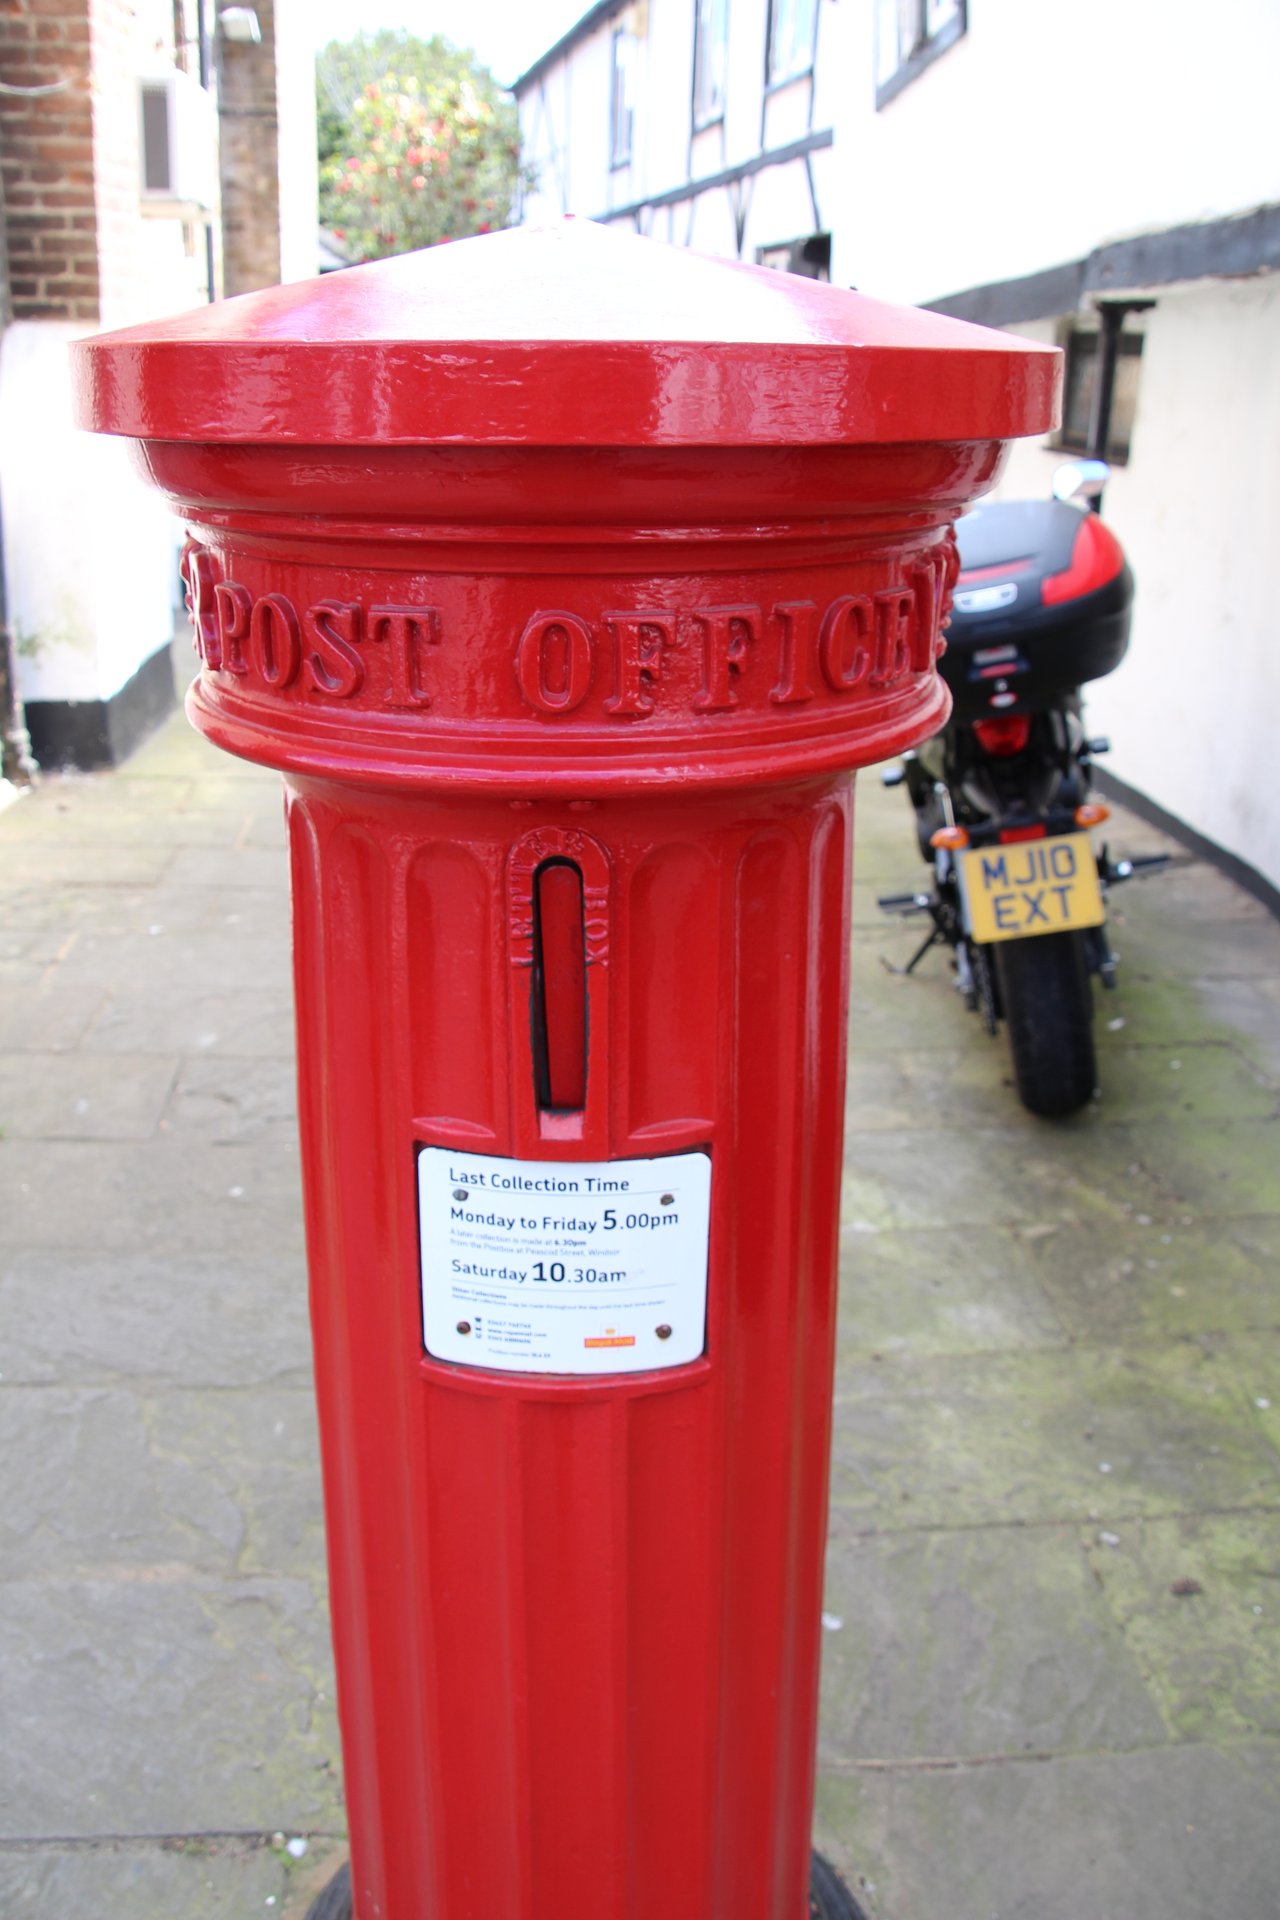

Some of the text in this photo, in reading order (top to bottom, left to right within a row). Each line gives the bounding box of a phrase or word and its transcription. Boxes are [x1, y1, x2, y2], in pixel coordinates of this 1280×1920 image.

[214, 579, 916, 715] POST OFFICE
[982, 844, 1077, 891] MJ10
[993, 885, 1073, 930] EXT
[449, 1167, 630, 1192] Last Collection Time
[450, 1206, 679, 1234] Monday to Friday 5.00pm
[451, 1259, 626, 1283] Saturday 10.30am
